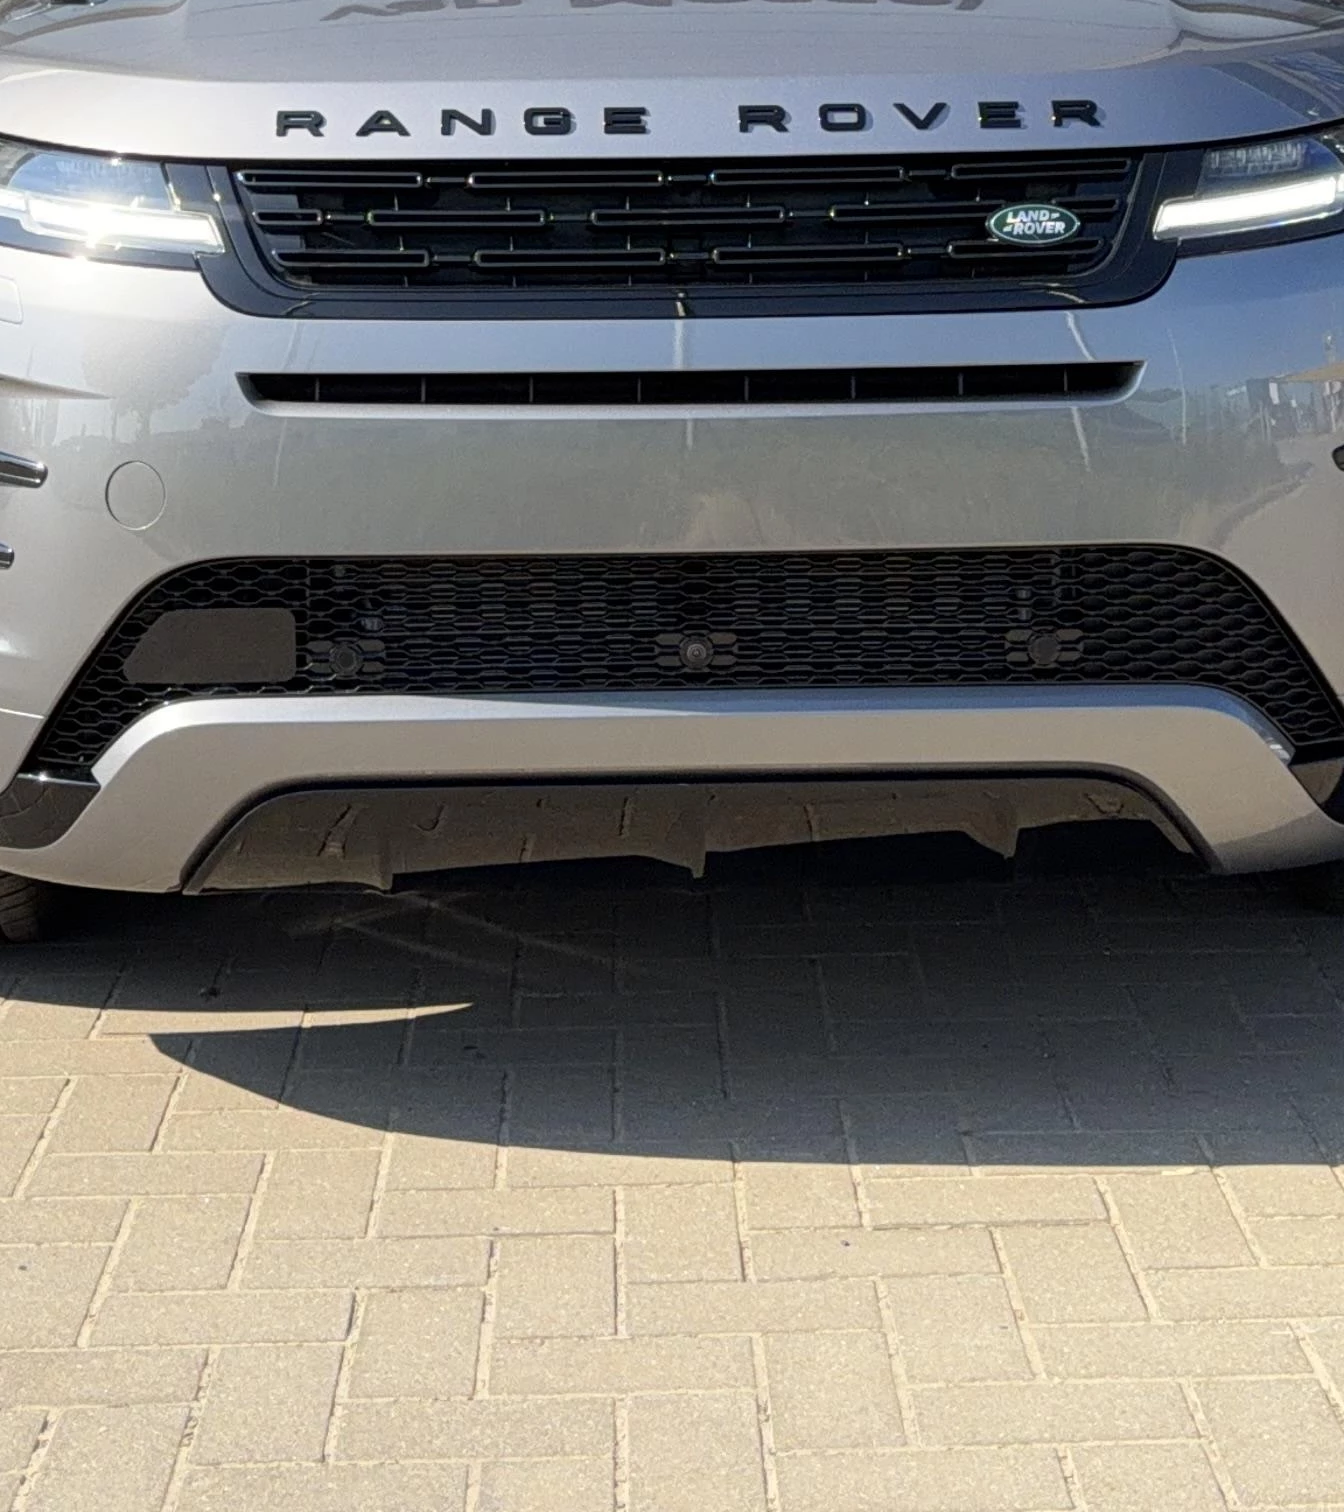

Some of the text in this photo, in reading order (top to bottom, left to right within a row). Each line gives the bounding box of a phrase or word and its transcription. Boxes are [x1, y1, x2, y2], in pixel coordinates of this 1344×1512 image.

[276, 99, 1107, 137] RANGE ROVER
[1006, 210, 1050, 223] LAND
[1013, 221, 1066, 235] ROVER
